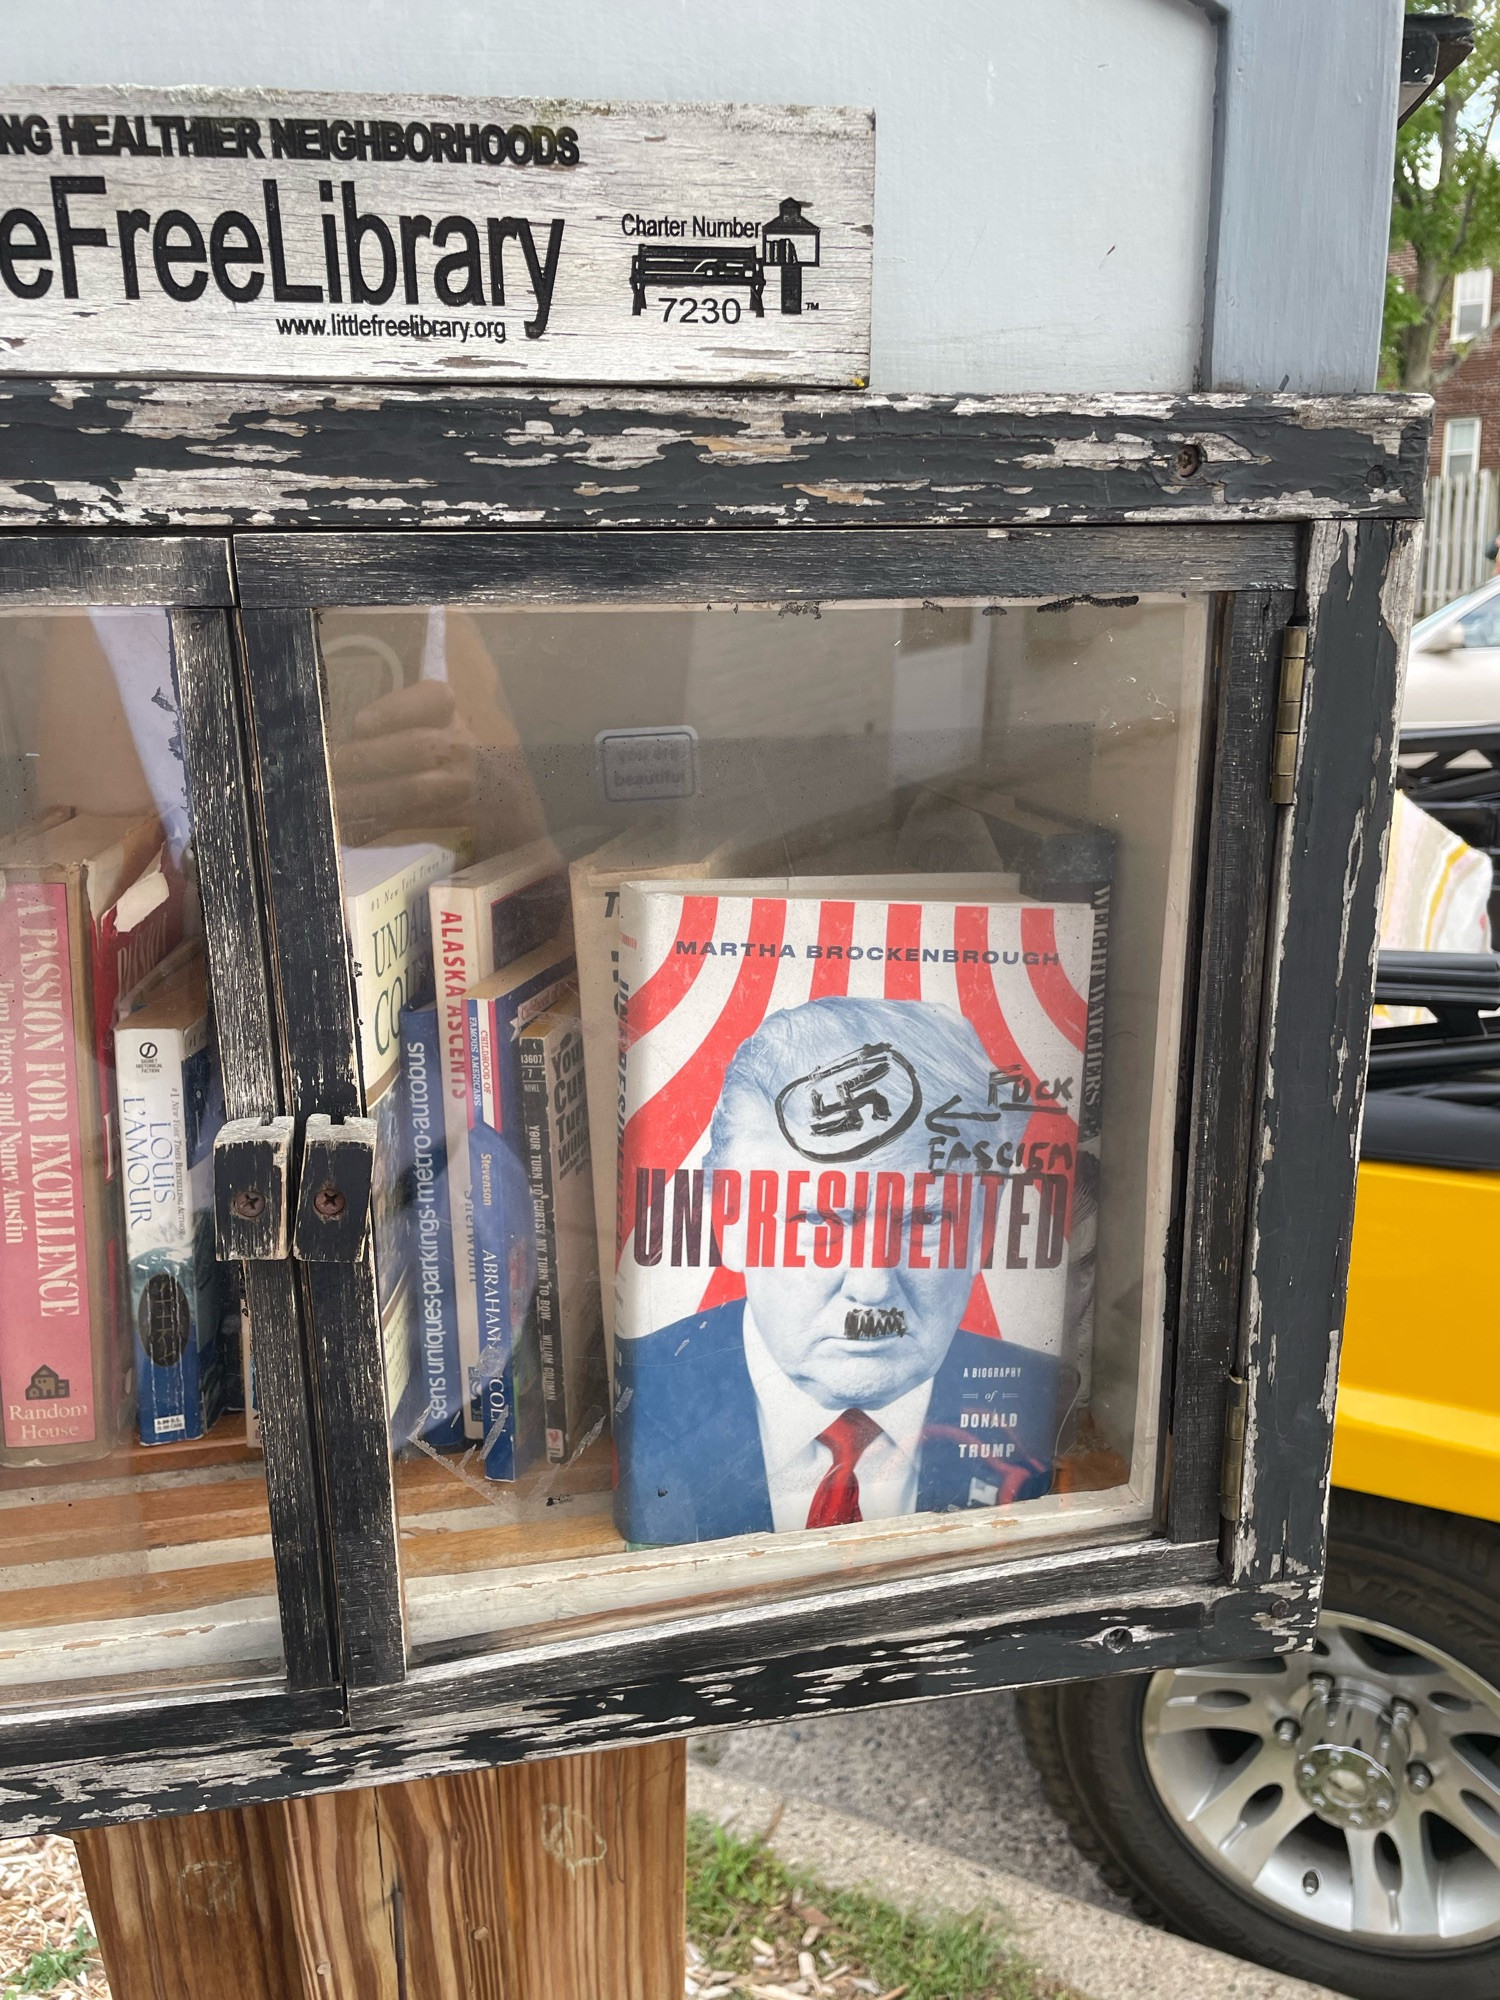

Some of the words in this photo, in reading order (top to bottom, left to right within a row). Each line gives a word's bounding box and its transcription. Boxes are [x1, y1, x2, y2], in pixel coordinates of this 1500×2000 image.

[58, 114, 266, 159] HEALTHIER
[269, 117, 580, 166] NEIGHBORHOODS
[621, 213, 687, 237] Charter
[692, 215, 762, 239] Number
[0, 176, 564, 339] eFreeLibrary
[658, 297, 741, 324] 7230
[275, 314, 507, 343] www.littlefreelibrary.org
[17, 897, 57, 918] A
[1090, 884, 1111, 980] WEIGHT
[440, 911, 467, 998] ALASKA
[676, 939, 796, 959] MARTHA
[805, 945, 1060, 967] BROCKENBROUGH
[19, 926, 64, 1052] PASSION
[469, 1016, 479, 1053] FAMOUS
[1084, 983, 1106, 1106] WATCHERS
[447, 1003, 467, 1101] ASCENTS
[481, 1030, 491, 1080] CHILDHOOD
[26, 1061, 68, 1123] FOR
[471, 1055, 482, 1107] AMERICANS
[483, 1082, 492, 1095] OF
[528, 1125, 541, 1150] YOUR
[927, 1136, 1074, 1171] FASCISM
[149, 1122, 176, 1204] LOUIS
[481, 1153, 492, 1207] Stevenson
[530, 1154, 543, 1179] TURN
[532, 1183, 543, 1196] TO
[3, 1186, 28, 1244] Austin
[30, 1133, 80, 1317] EXCELLENCE
[533, 1198, 546, 1235] CURTSY
[634, 1167, 1070, 1269] UNPRESIDENTED
[536, 1238, 548, 1252] MY
[537, 1256, 549, 1280] TURN
[482, 1249, 502, 1341] ABRAHAM
[539, 1284, 550, 1297] TO
[540, 1299, 552, 1321] BOW
[542, 1334, 555, 1364] WILLIAM
[543, 1367, 557, 1401] GOLDMAN
[962, 1367, 969, 1378] A
[972, 1367, 1022, 1378] BIOGRAPHY
[8, 1403, 89, 1421] Random
[427, 1377, 448, 1420] sens
[984, 1390, 998, 1403] of
[20, 1423, 80, 1441] House
[960, 1412, 1018, 1428] DONALD
[958, 1443, 1016, 1459] TRUMP
